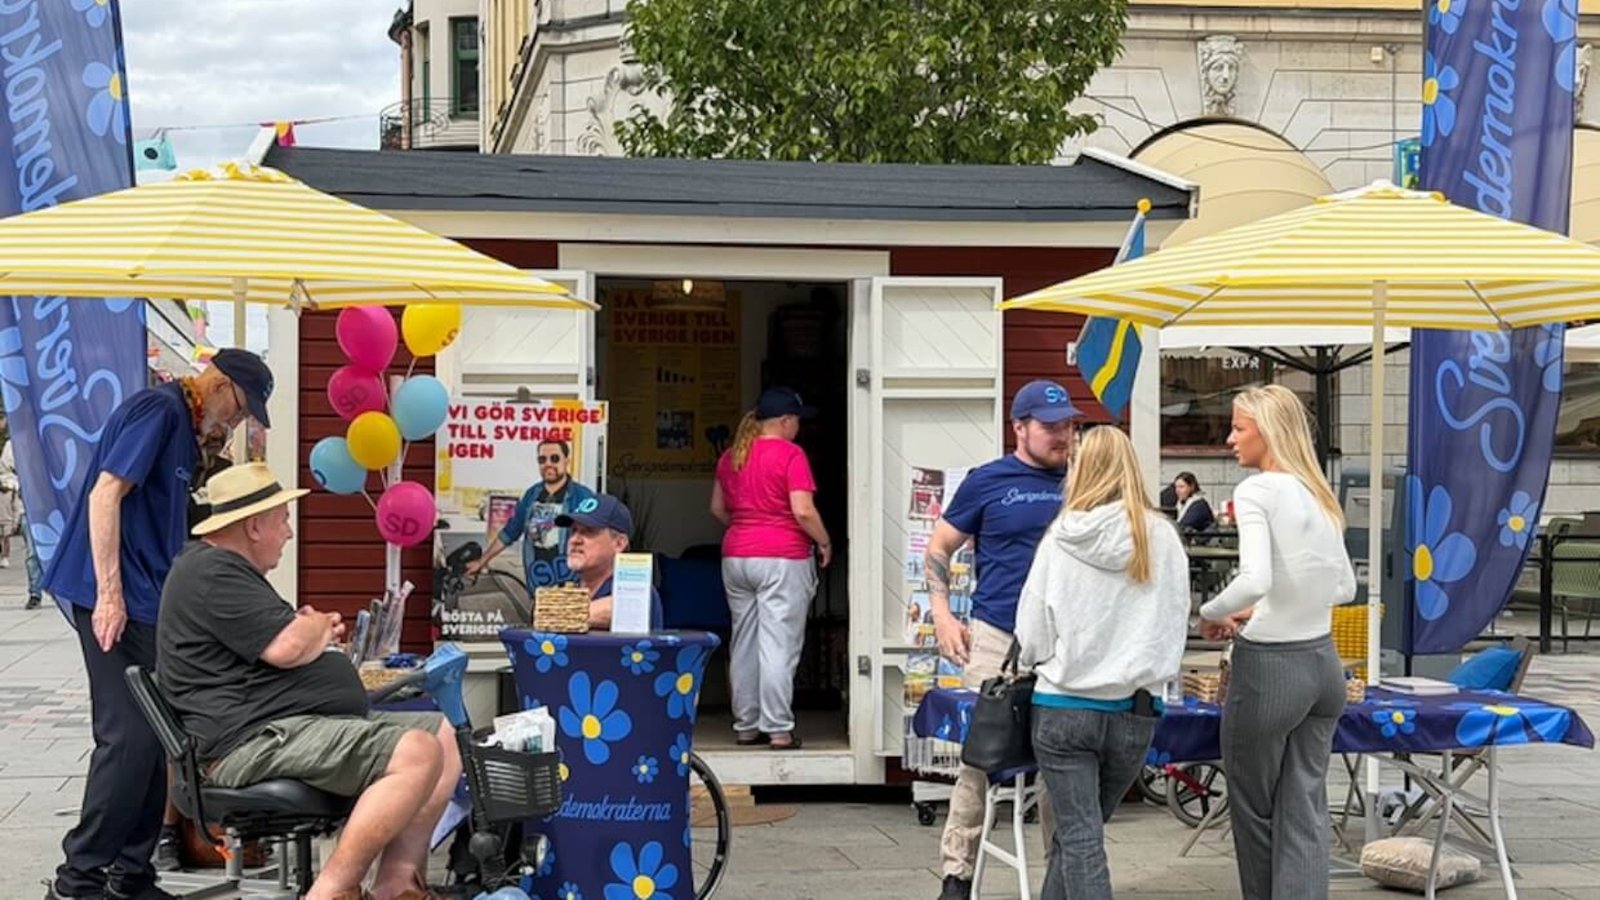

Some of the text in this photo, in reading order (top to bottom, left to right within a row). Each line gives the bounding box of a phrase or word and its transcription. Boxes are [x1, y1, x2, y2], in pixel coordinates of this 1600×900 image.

[613, 310, 731, 327] SVERIGE TILL
[613, 328, 735, 344] SVERIGE IGEN
[338, 384, 369, 413] SD
[448, 401, 600, 424] VI GÖR SVERIGE
[448, 424, 574, 442] TILL SVERIGE
[448, 443, 494, 459] IGEN
[385, 512, 420, 537] SD
[441, 608, 505, 623] RÖSTA PÅ
[556, 793, 671, 820] demokraterna
